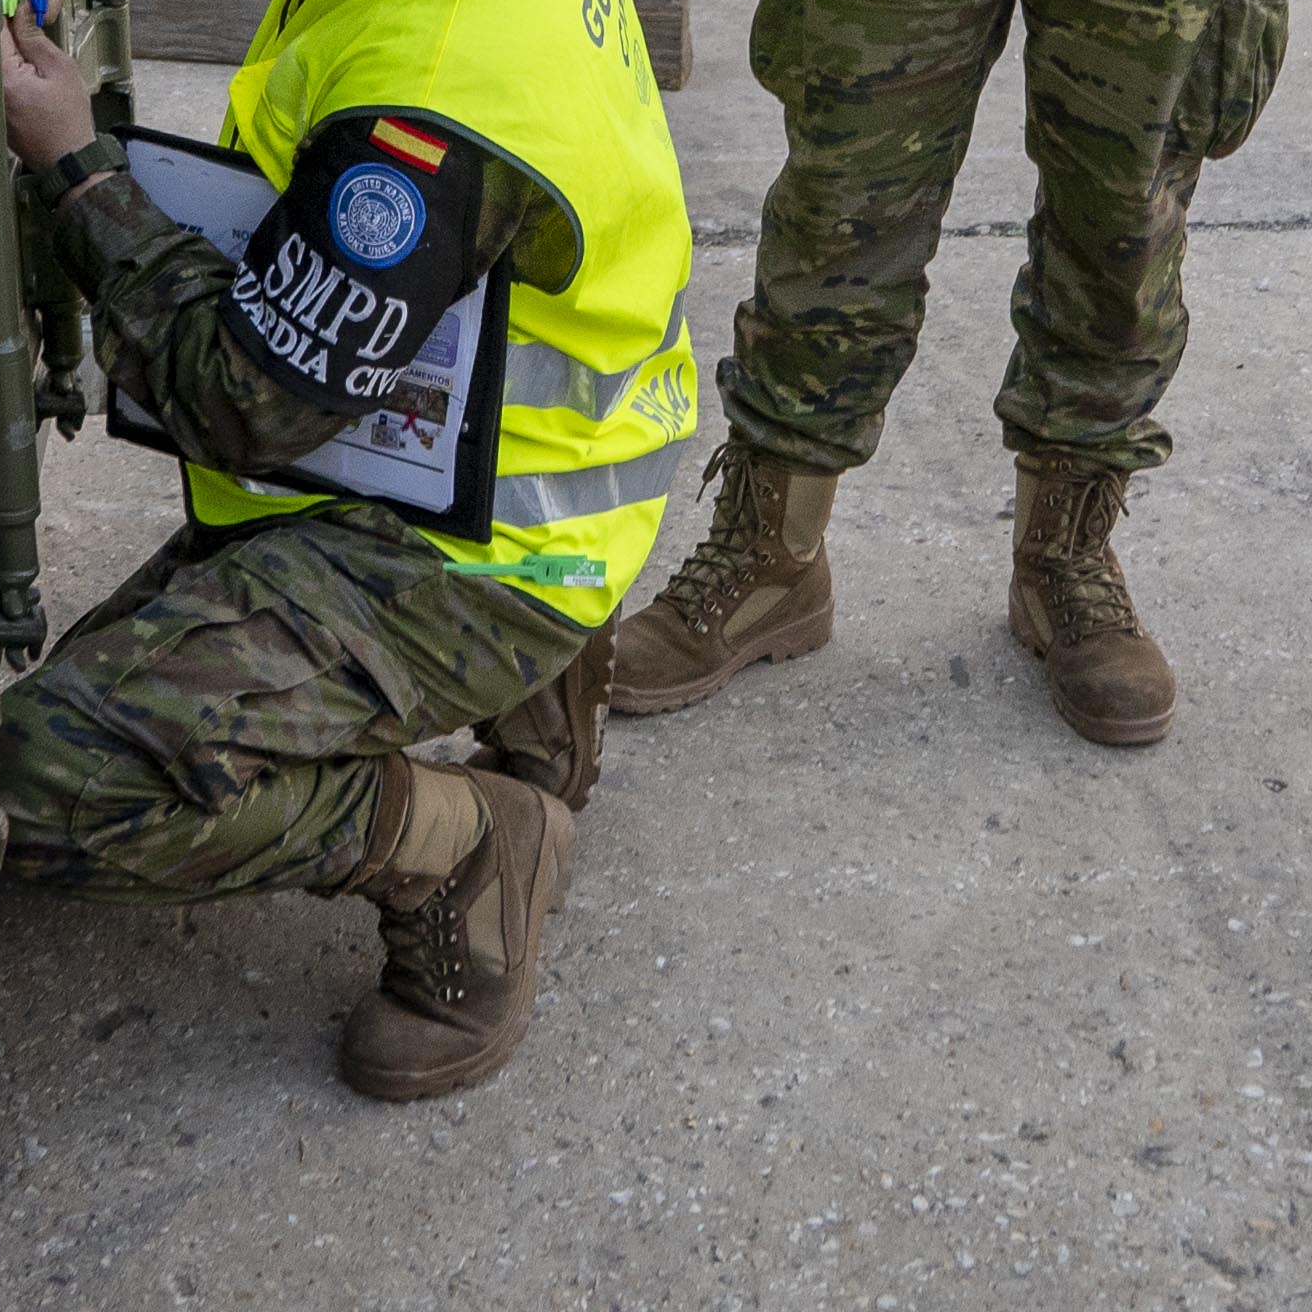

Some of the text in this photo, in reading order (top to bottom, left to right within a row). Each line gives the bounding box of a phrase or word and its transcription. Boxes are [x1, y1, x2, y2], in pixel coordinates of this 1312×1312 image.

[351, 179, 412, 222] UNITED NATIONS
[338, 212, 398, 257] NATIONS UNIES
[263, 232, 408, 362] SMPD
